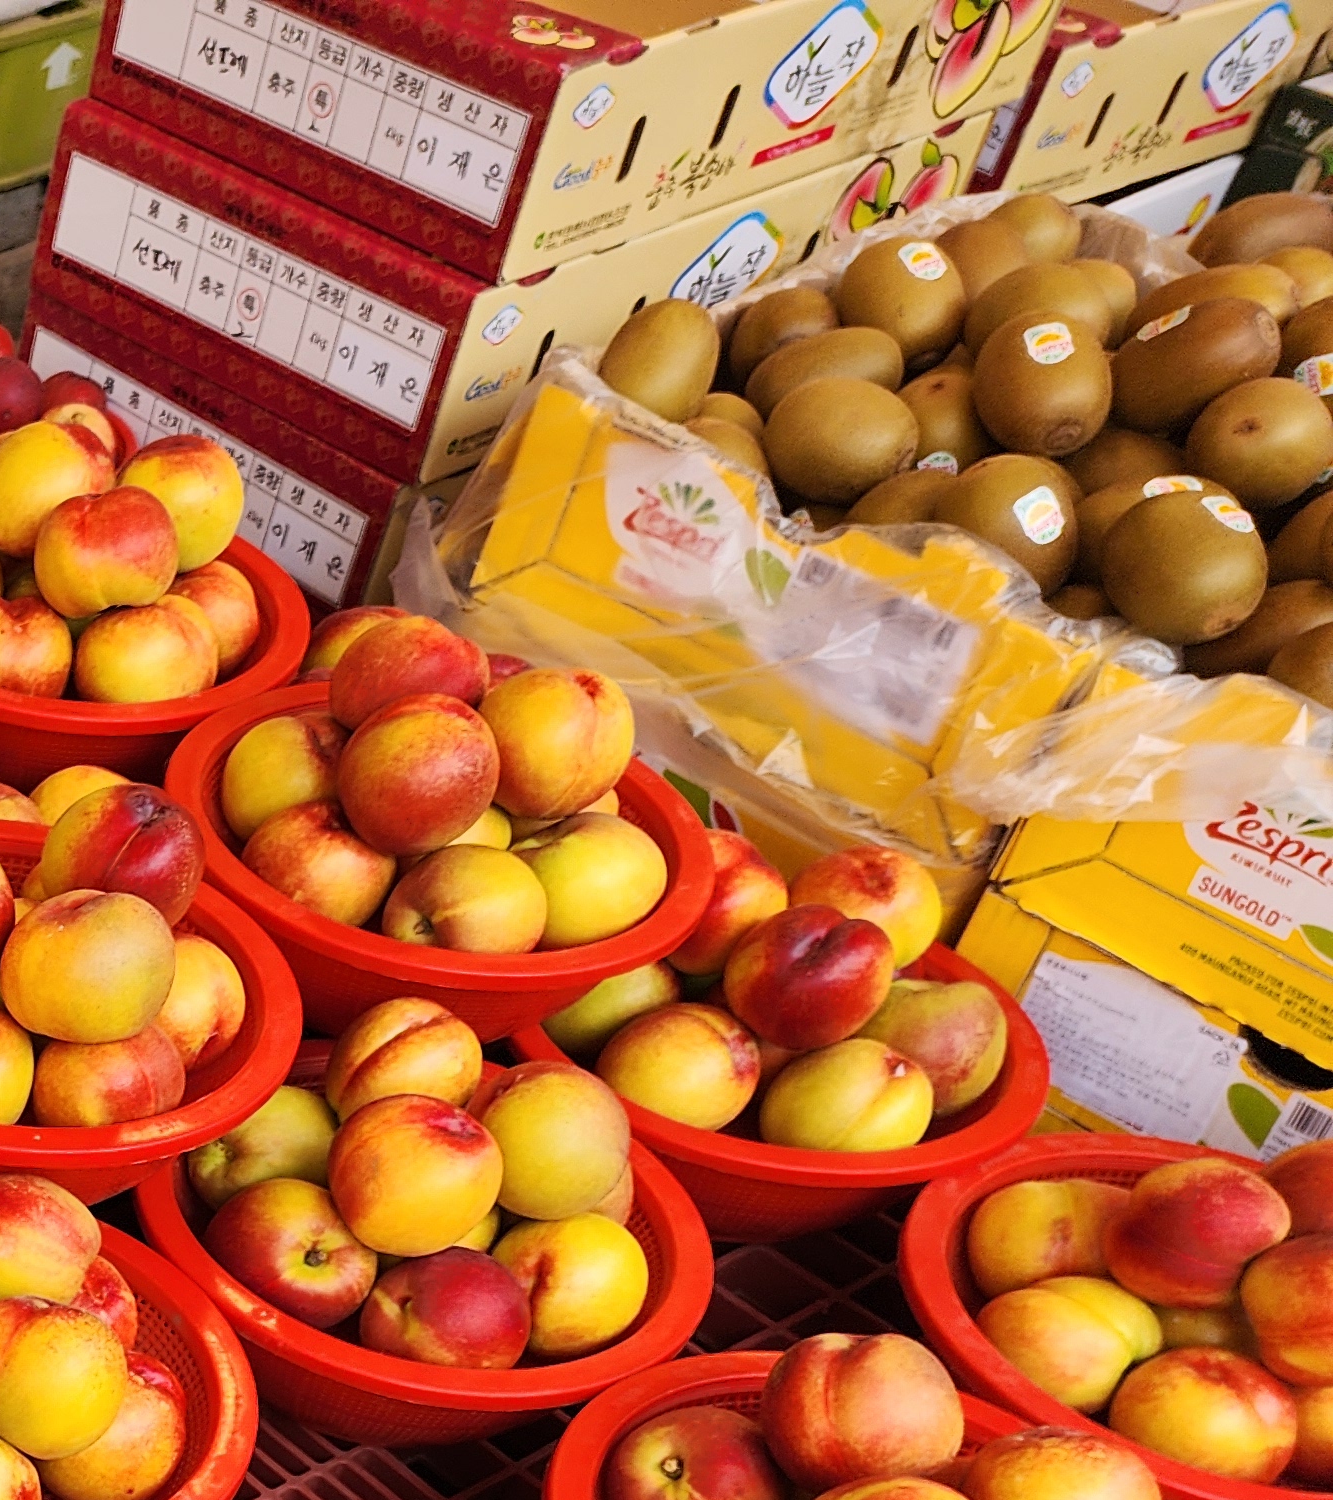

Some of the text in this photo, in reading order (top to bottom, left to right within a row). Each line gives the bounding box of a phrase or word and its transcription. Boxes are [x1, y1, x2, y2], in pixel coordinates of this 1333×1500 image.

[280, 23, 310, 50] 산지
[318, 37, 347, 67] 등급
[353, 53, 385, 82] 개수
[392, 71, 425, 100] 중량
[209, 230, 237, 256] 산지
[243, 246, 273, 274] 등급
[280, 263, 309, 290] 개수
[316, 282, 346, 309] 중량
